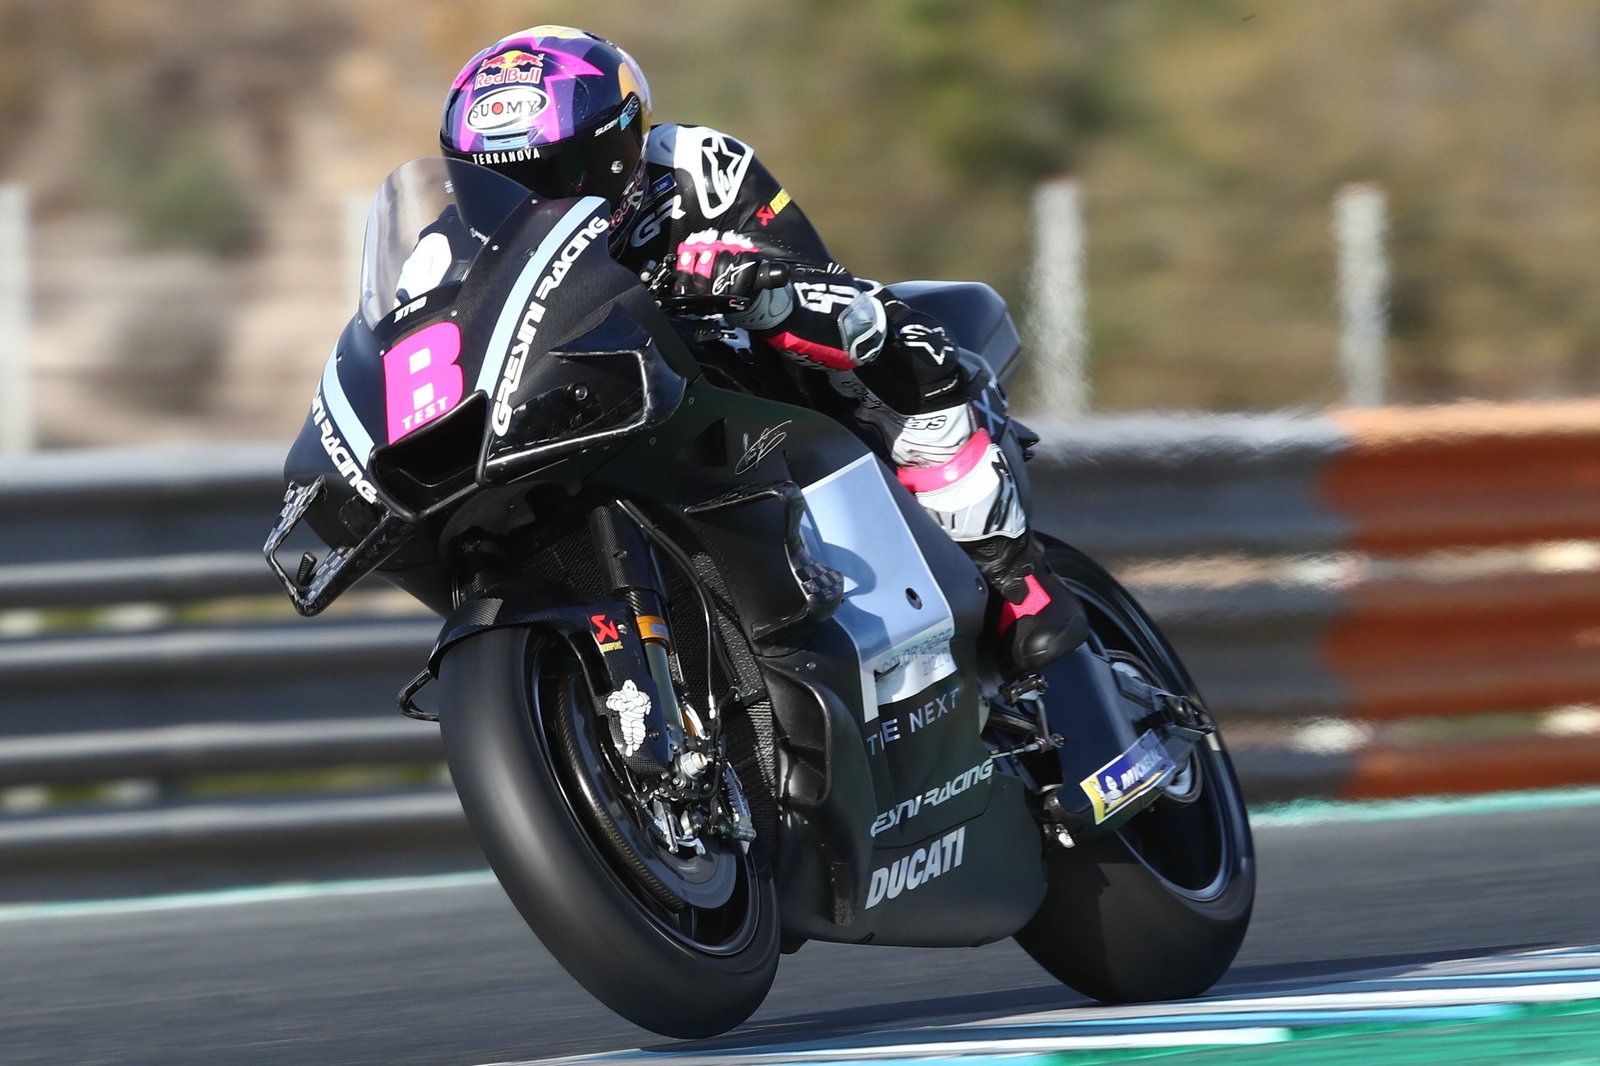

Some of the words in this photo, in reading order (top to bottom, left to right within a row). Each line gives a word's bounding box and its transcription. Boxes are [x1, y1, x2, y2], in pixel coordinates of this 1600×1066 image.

[475, 69, 505, 90] Red
[506, 68, 542, 84] Bull
[472, 100, 538, 119] SUOMY
[472, 147, 541, 165] TERRANOVA
[491, 301, 547, 437] GRESINI
[535, 216, 609, 301] RACING
[402, 396, 449, 430] TEST
[320, 417, 378, 505] RACING
[908, 687, 960, 734] NEXT
[923, 757, 995, 807] RACING
[864, 826, 967, 910] DUCATI
